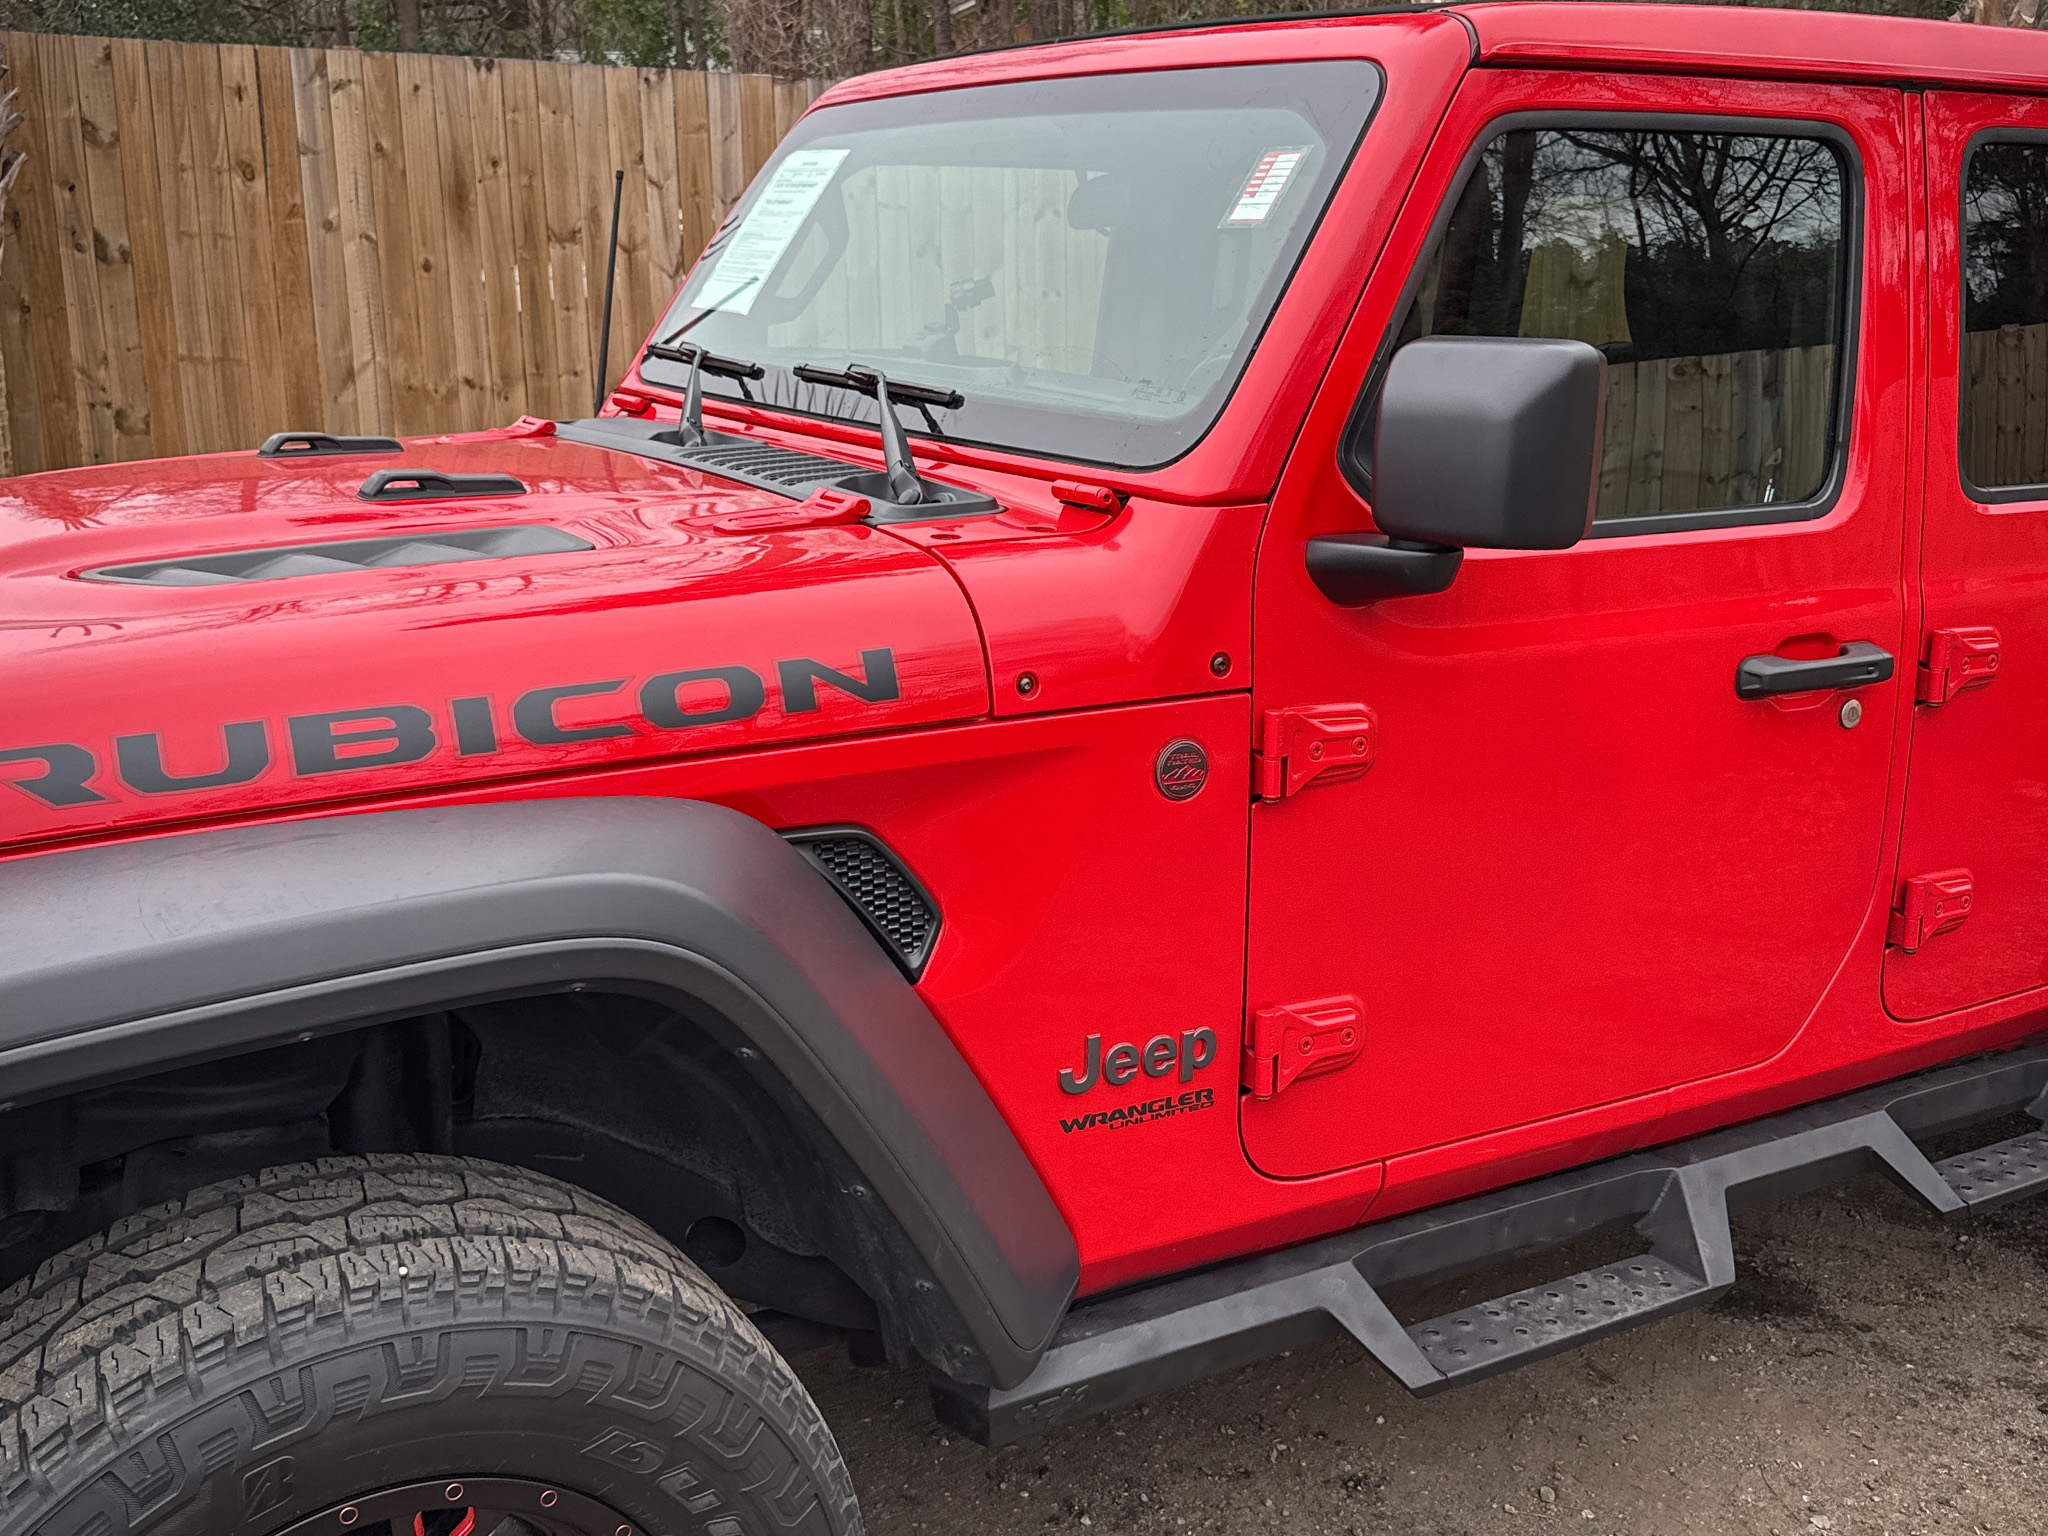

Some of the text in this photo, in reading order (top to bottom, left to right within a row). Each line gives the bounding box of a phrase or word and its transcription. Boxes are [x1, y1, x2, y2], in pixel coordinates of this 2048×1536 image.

[0, 647, 901, 808] RUBICON
[1058, 1026, 1217, 1095] Jeep
[1059, 1088, 1214, 1134] WRANGLER
[1109, 1101, 1215, 1131] UNLIMITED
